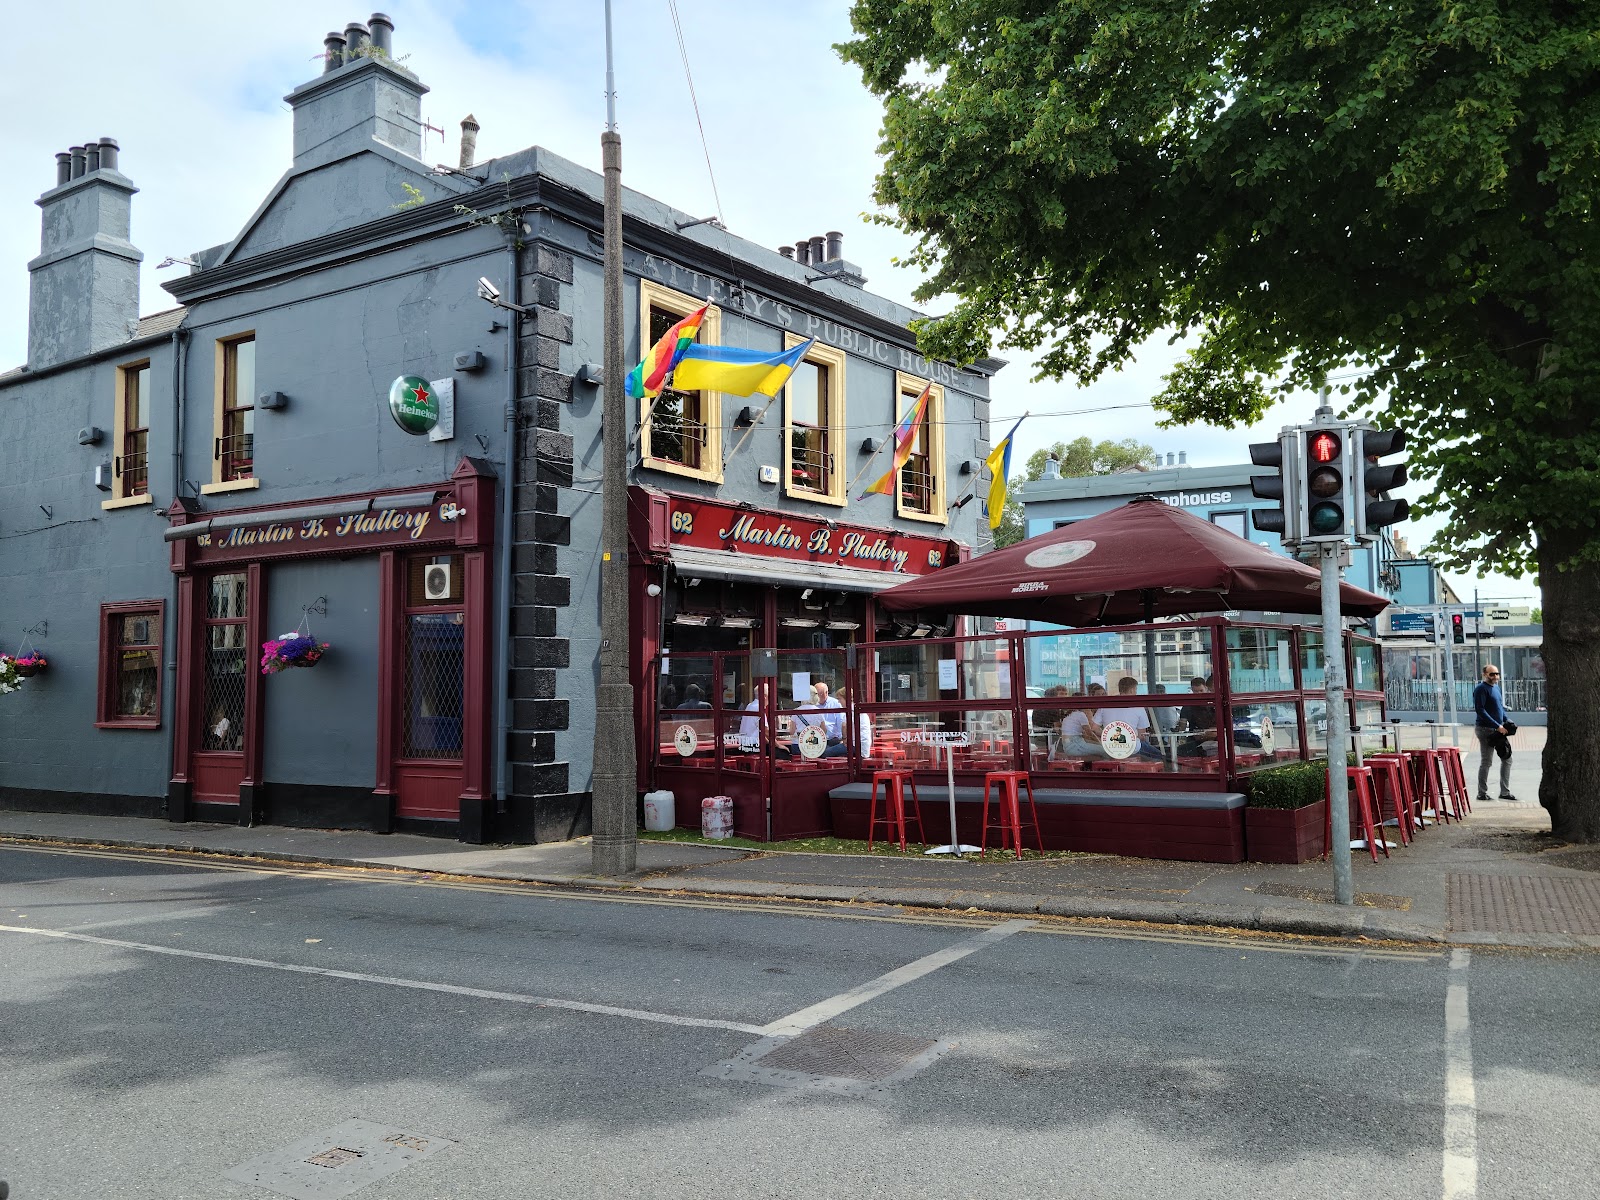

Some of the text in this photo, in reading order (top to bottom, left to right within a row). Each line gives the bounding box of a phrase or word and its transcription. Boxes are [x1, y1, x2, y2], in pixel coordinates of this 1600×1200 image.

[805, 314, 889, 362] PUBLIC
[900, 351, 960, 388] HOUSE
[398, 403, 438, 420] Heineken
[218, 524, 295, 548] Martin
[301, 519, 329, 539] B.
[335, 509, 431, 540] Slattery
[671, 511, 942, 573] 62 Martin B. Slattery 62
[1011, 585, 1049, 593] MORETTI
[900, 731, 968, 743] SLATTERY'S
